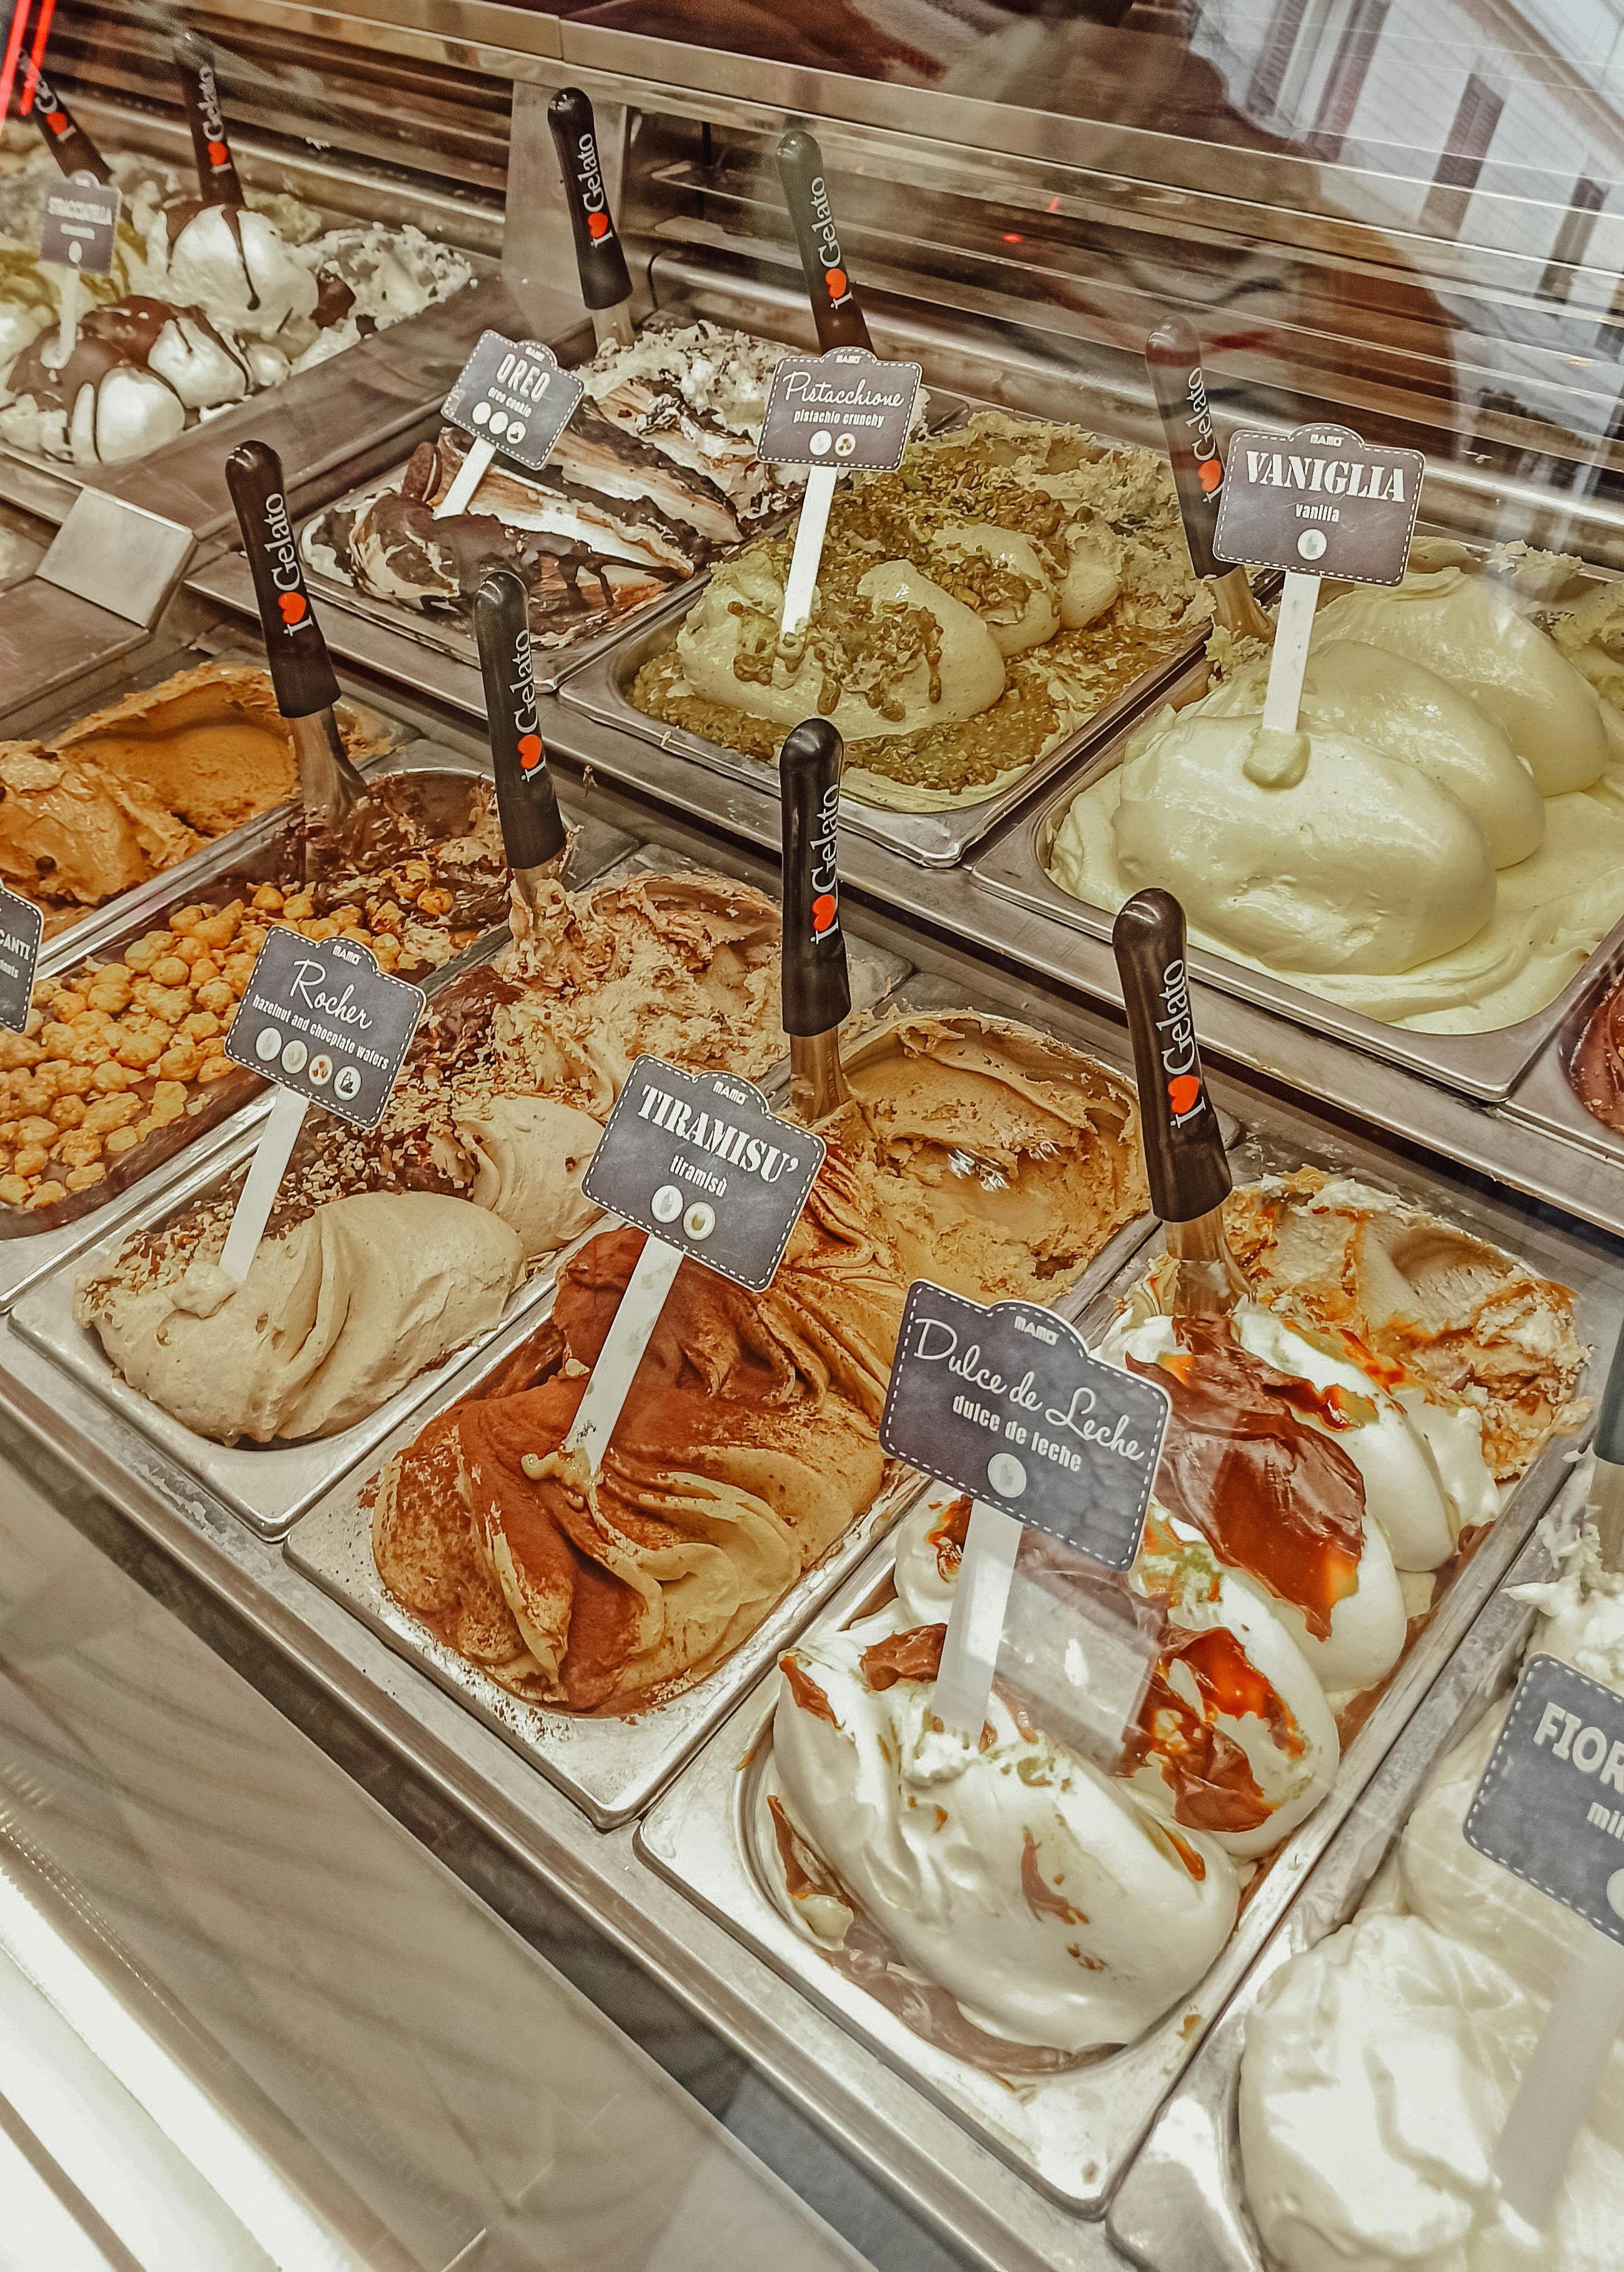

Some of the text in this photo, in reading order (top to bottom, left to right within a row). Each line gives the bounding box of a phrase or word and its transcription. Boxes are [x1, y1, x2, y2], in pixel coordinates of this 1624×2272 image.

[577, 134, 604, 212] Gelato
[810, 177, 841, 268] Gelato
[496, 354, 550, 403] OREO
[783, 370, 905, 407] Pistacchione
[1185, 367, 1216, 461] Gelato
[793, 409, 884, 429] pistachio crunchy
[1245, 450, 1405, 503] VANIGLIA
[1294, 504, 1340, 523] vanilla
[264, 493, 300, 592] Gelato
[510, 629, 539, 734] Gelato
[810, 783, 839, 894] Gelato
[252, 994, 292, 1023] hazelnut
[290, 1014, 310, 1032] and
[356, 1045, 390, 1071] wafers
[290, 958, 374, 1030] Rocher
[1156, 960, 1196, 1075] Gelato
[914, 1318, 1145, 1461] Dulce de Leche
[952, 1394, 1082, 1472] dulce de leche
[1586, 1801, 1624, 1843] mil
